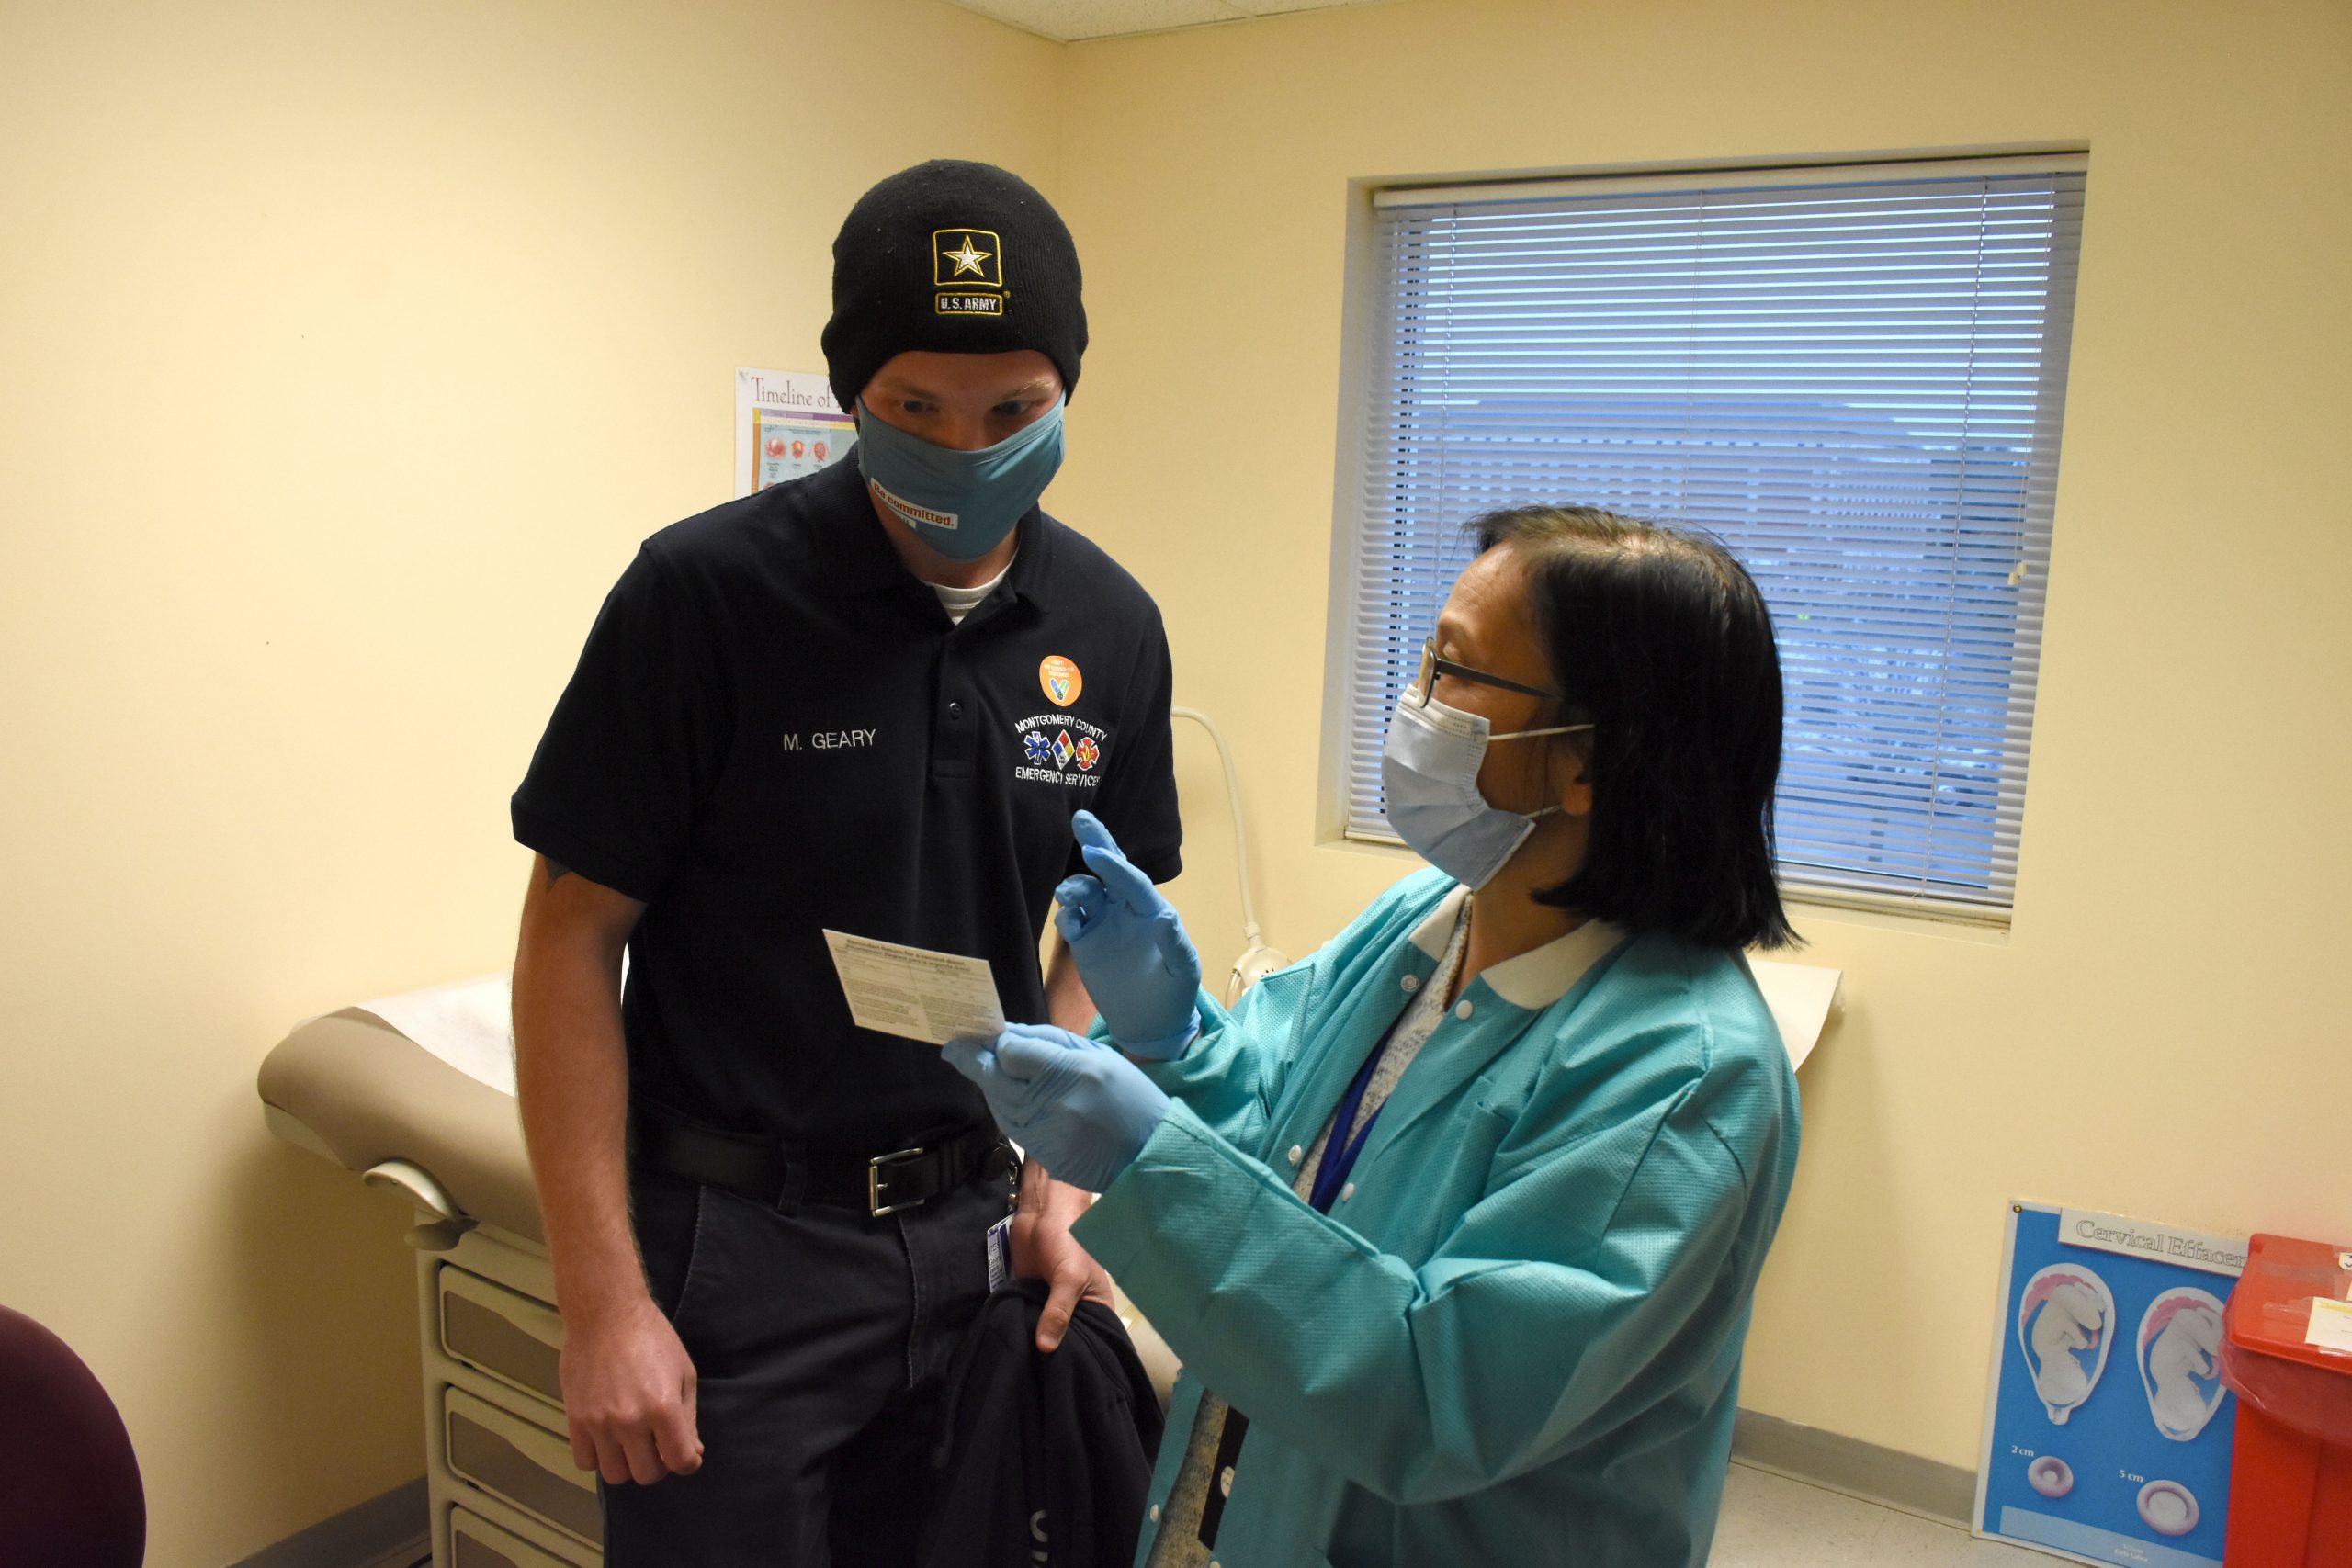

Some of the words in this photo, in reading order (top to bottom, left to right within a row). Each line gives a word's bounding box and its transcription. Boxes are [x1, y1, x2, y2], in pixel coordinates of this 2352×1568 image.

[941, 297, 962, 310] U.S.
[964, 297, 997, 311] ARMY
[751, 376, 813, 406] Timeline
[817, 384, 831, 408] of
[888, 495, 955, 526] committed.
[783, 733, 803, 751] M.
[811, 728, 876, 750] GEARY
[1014, 714, 1075, 734] MONTGOMERY
[1075, 718, 1108, 742] COUNTY
[2075, 1219, 2164, 1253] Cervical
[2011, 1445, 2018, 1454] 2
[2018, 1448, 2035, 1458] cm
[2118, 1469, 2126, 1479] 5
[2127, 1472, 2144, 1483] cm
